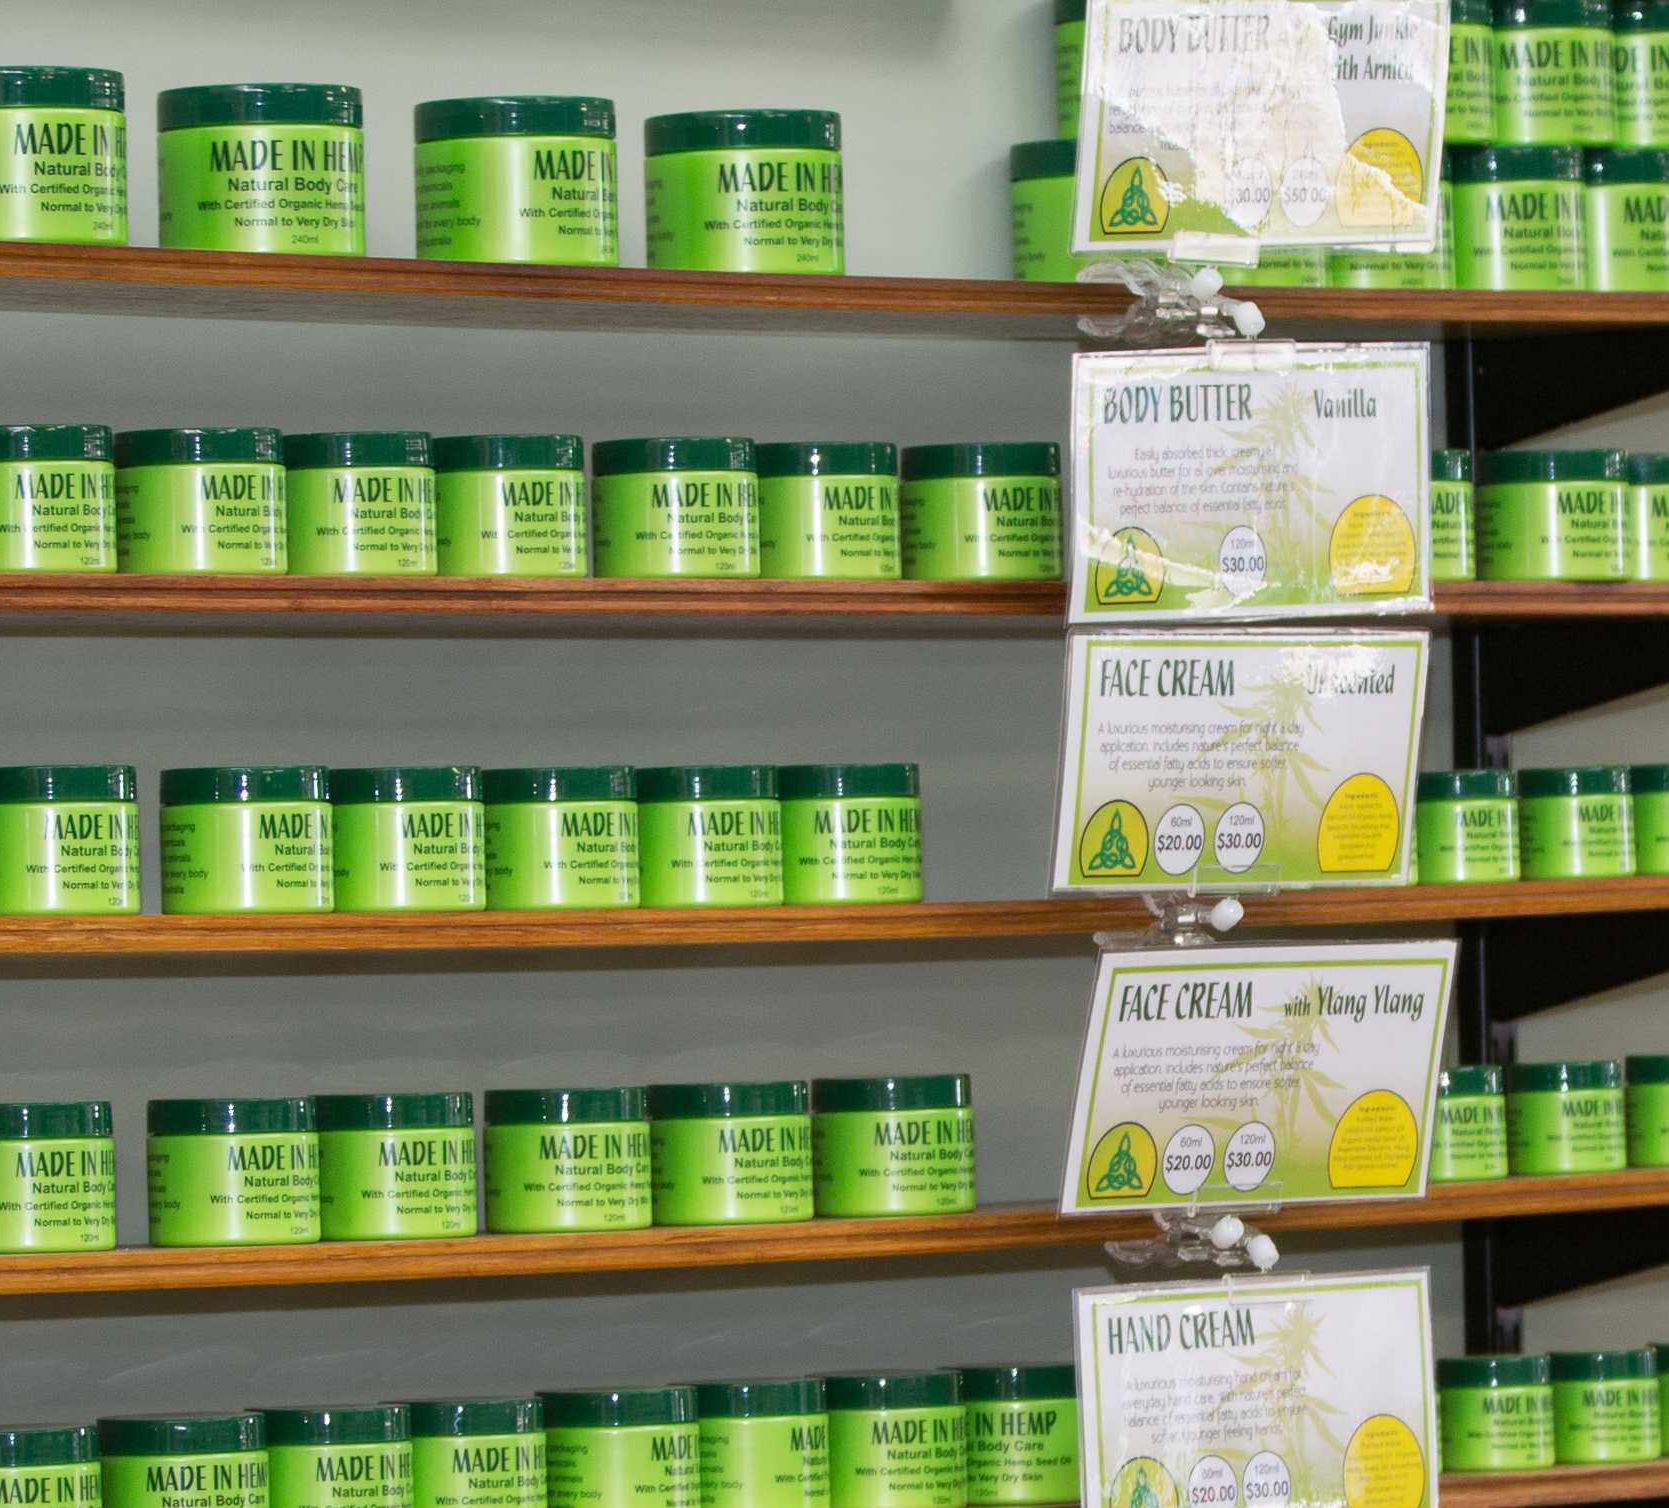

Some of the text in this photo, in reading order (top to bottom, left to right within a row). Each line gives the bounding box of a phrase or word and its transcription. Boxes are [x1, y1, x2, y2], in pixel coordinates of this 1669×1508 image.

[1118, 16, 1181, 54] BODY
[1500, 40, 1563, 69] MADE
[210, 140, 315, 172] MADE IN
[228, 177, 332, 194] Natural Body
[279, 199, 323, 210] Organic
[235, 217, 277, 227] Normal
[281, 217, 292, 226] to
[297, 217, 320, 228] Very
[1102, 383, 1252, 425] BODY BUTTER
[1314, 388, 1376, 418] Vanilla
[1222, 556, 1265, 573] $30.00
[1100, 659, 1235, 697] FACE CREAM
[814, 808, 897, 837] MADE IN
[1230, 815, 1254, 827] 120ml
[1157, 832, 1262, 852] $20.00 $30.00
[1118, 981, 1425, 1022] FACE CREAM with Ylang Ylang
[1240, 1134, 1265, 1145] 120ml
[1165, 1151, 1272, 1171] $20.00 $30.00
[1107, 1309, 1255, 1354] HAND CREAM
[975, 1411, 1057, 1437] IN HEMP
[978, 1440, 1044, 1454] Body Care
[1192, 1481, 1289, 1504] $20.00 $30.00
